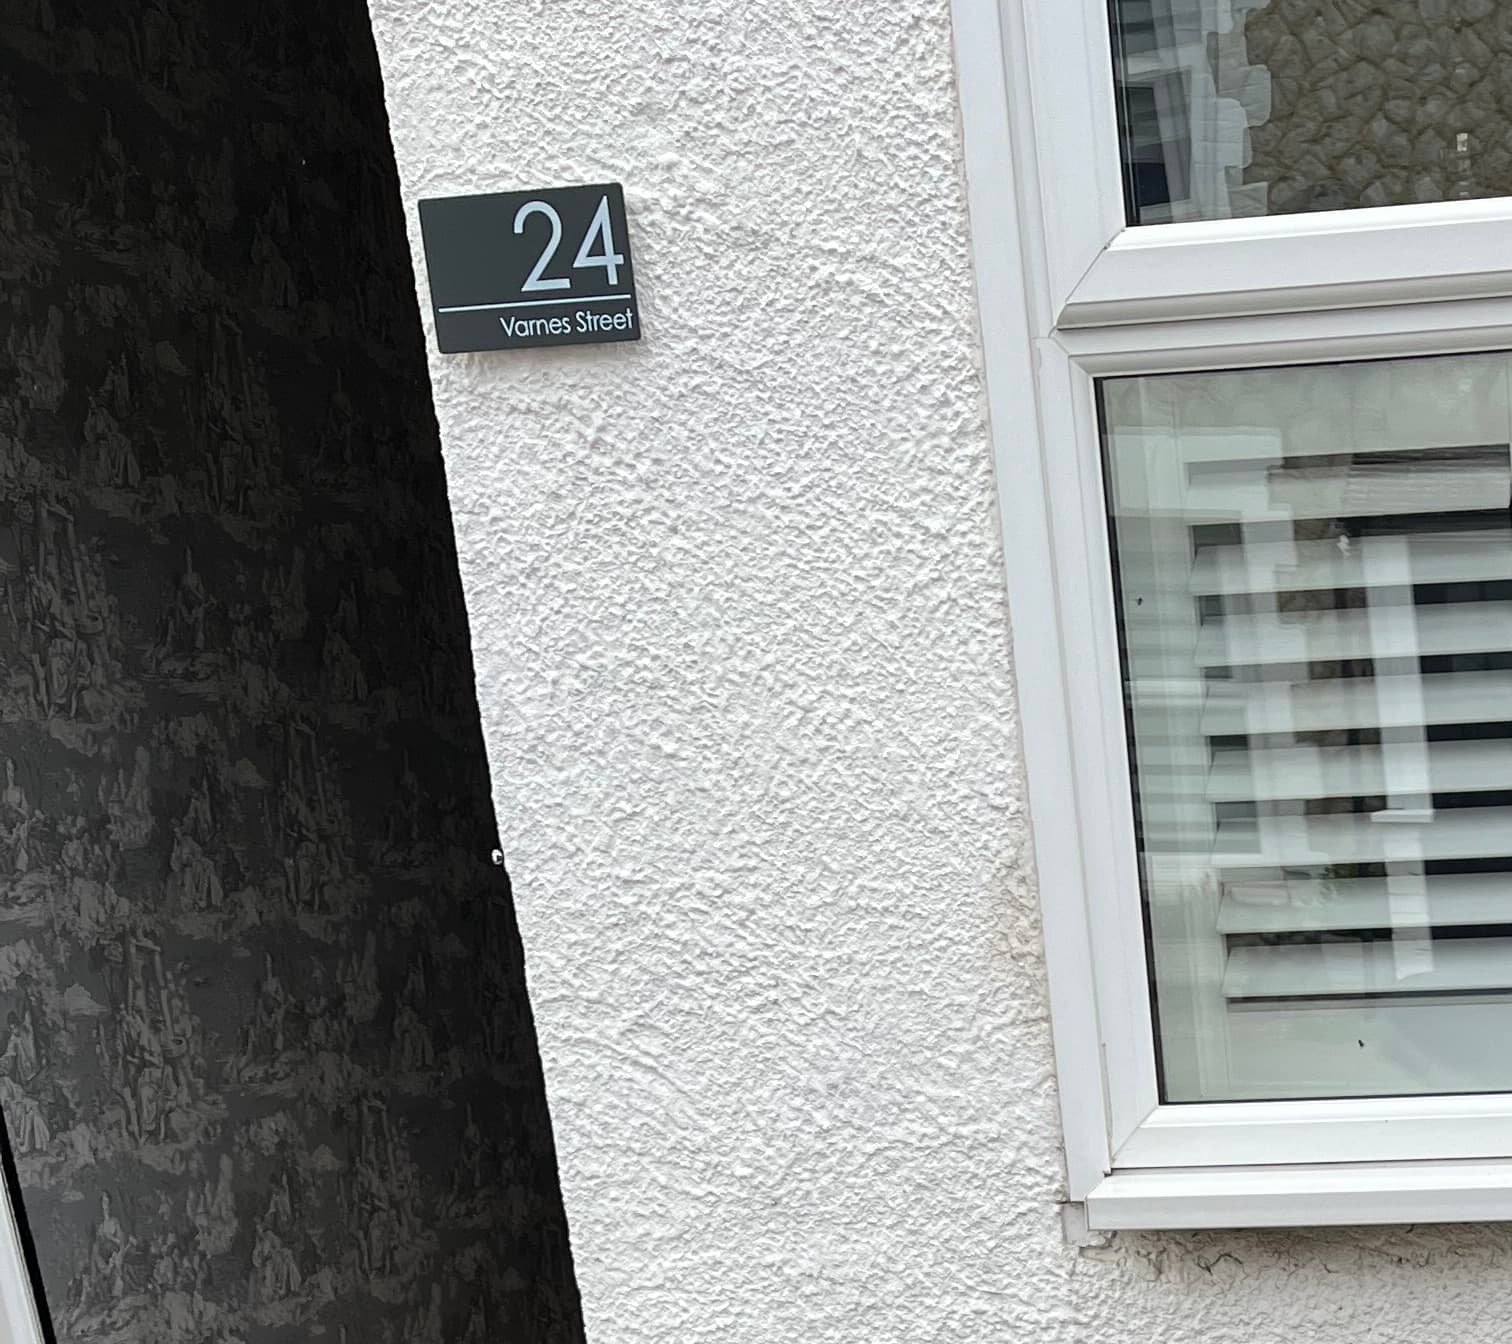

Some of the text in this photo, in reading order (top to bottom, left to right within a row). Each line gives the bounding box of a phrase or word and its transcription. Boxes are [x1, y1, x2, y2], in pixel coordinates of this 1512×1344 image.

[514, 195, 625, 292] 24
[499, 308, 633, 337] Varnes Street
